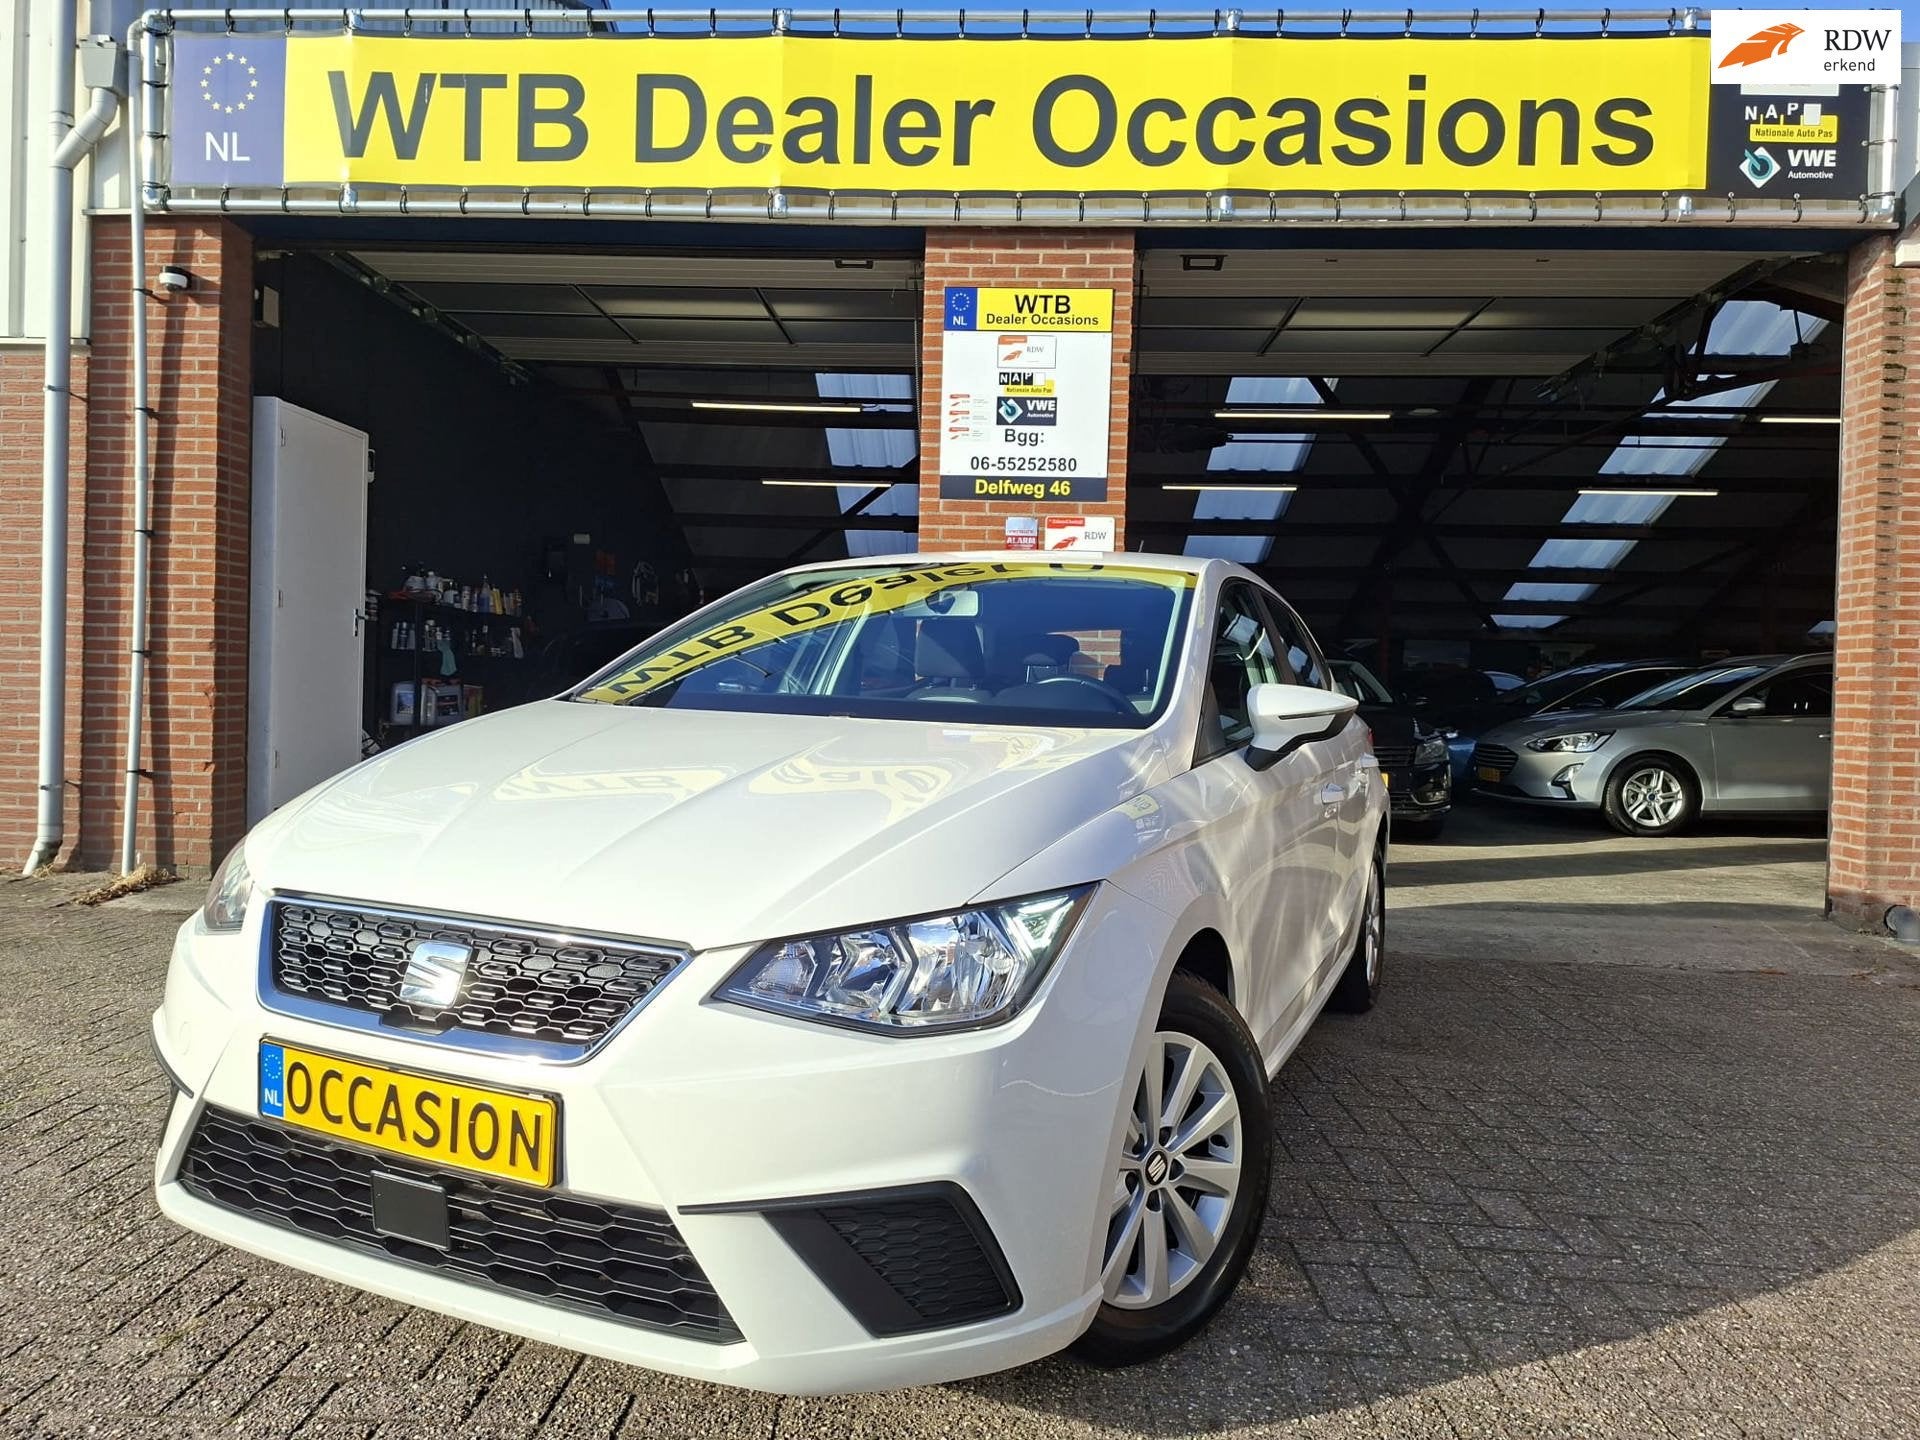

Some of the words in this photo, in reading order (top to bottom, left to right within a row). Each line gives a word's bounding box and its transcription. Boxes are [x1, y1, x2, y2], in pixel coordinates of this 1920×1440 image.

[327, 70, 590, 163] WTB
[634, 73, 996, 167] Dealer
[1032, 74, 1655, 168] Occasions
[1754, 127, 1795, 138] Nationale
[1796, 128, 1816, 139] Auto
[1817, 129, 1834, 139] Pas
[204, 132, 250, 162] NL
[1787, 149, 1837, 168] VWE
[1787, 170, 1834, 180] Automotive
[1014, 294, 1072, 315] WTB
[952, 315, 968, 326] NL
[986, 313, 1027, 326] Dealer
[1031, 314, 1099, 327] Occasions
[1026, 345, 1045, 353] RDW
[1026, 400, 1056, 411] VWE
[1004, 428, 1045, 447] Bgg:
[970, 456, 1077, 472] 06-55252580
[975, 479, 1045, 499] Delfweg
[1050, 480, 1071, 496] 46
[1006, 536, 1036, 545] ALARM
[1084, 531, 1107, 540] RDW
[264, 1087, 283, 1107] NL
[286, 1061, 543, 1172] OCCASION
